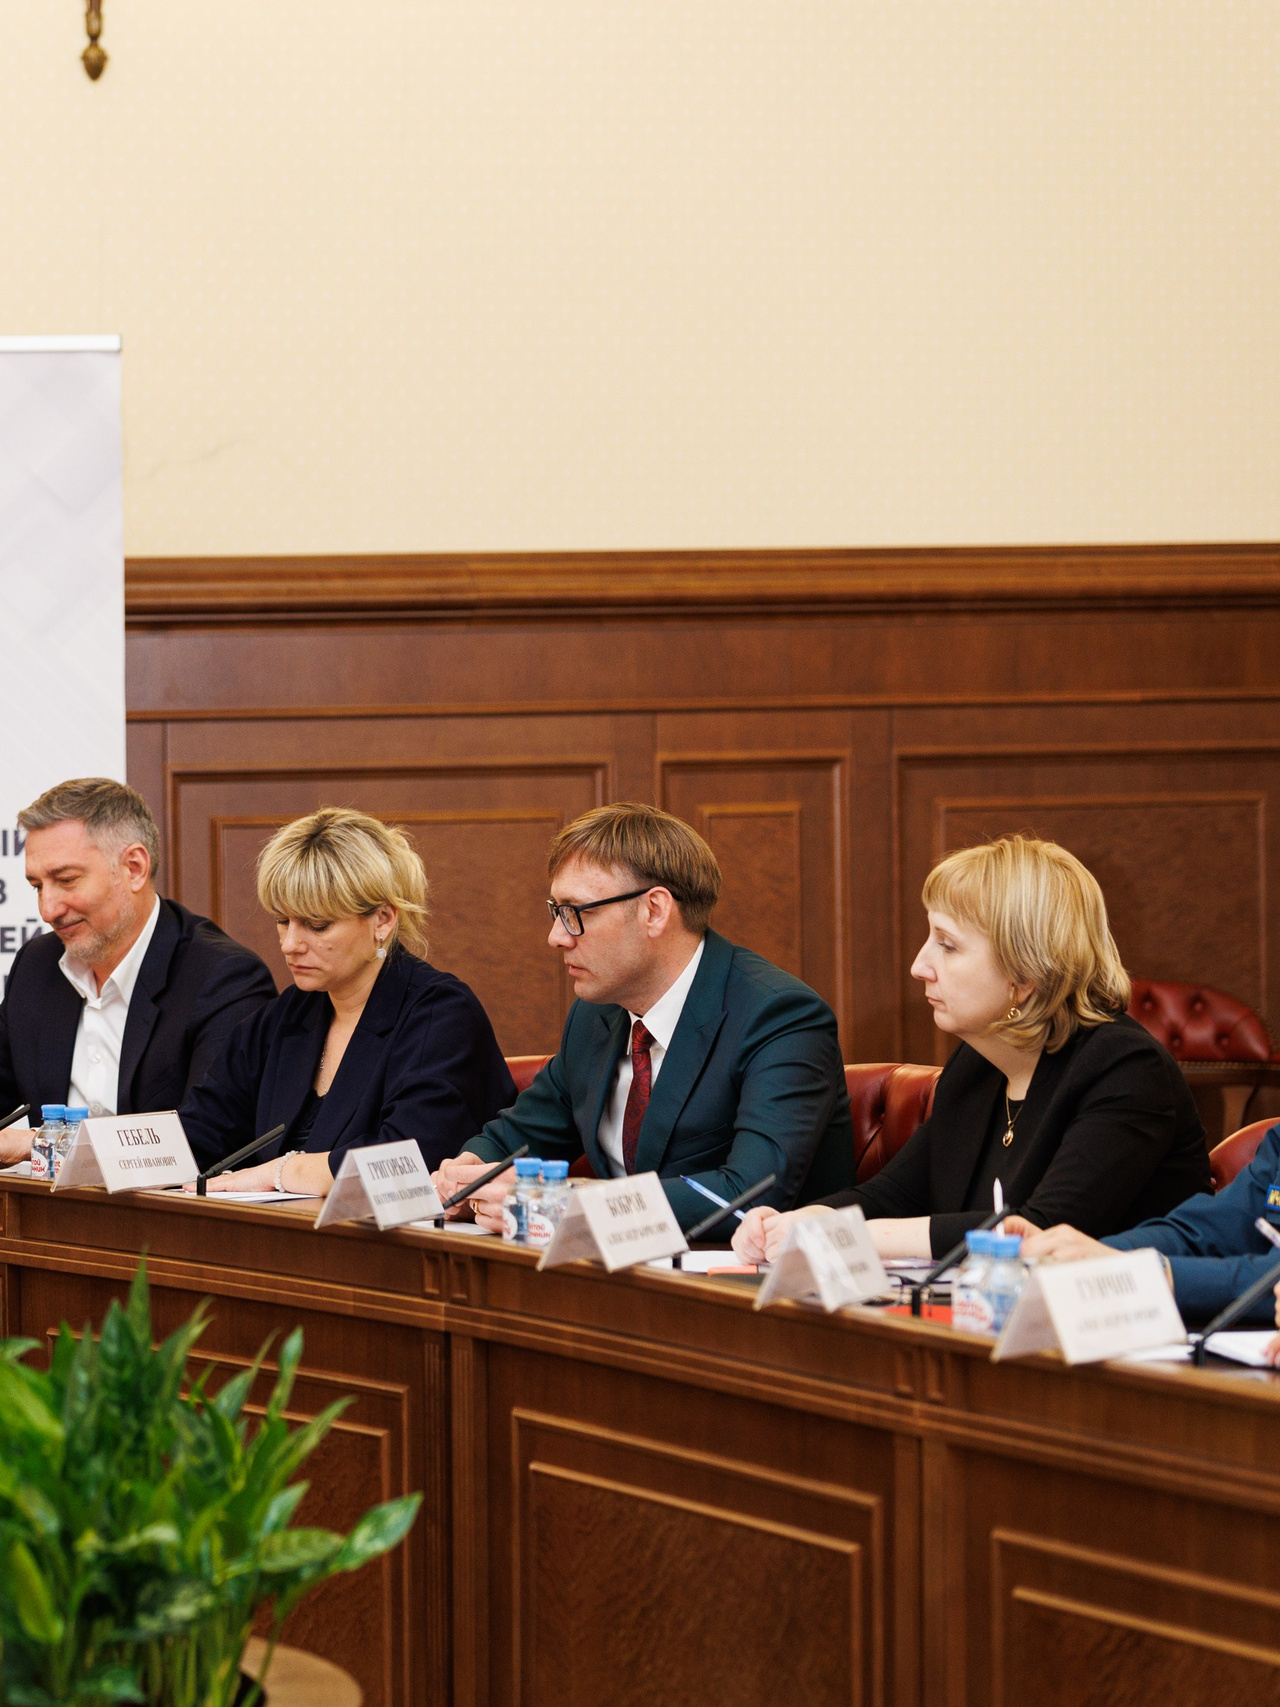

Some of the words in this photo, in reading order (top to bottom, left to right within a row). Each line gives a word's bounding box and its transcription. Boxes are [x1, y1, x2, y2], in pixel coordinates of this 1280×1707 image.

[116, 1127, 161, 1147] ГЕБЕЛЬ
[118, 1157, 144, 1171] СЕРГЕЙ
[144, 1156, 178, 1169] ИВАНОВИЧ
[367, 1155, 420, 1181] ГРИГОРЬЕВА
[605, 1191, 648, 1218] БОБРОВ
